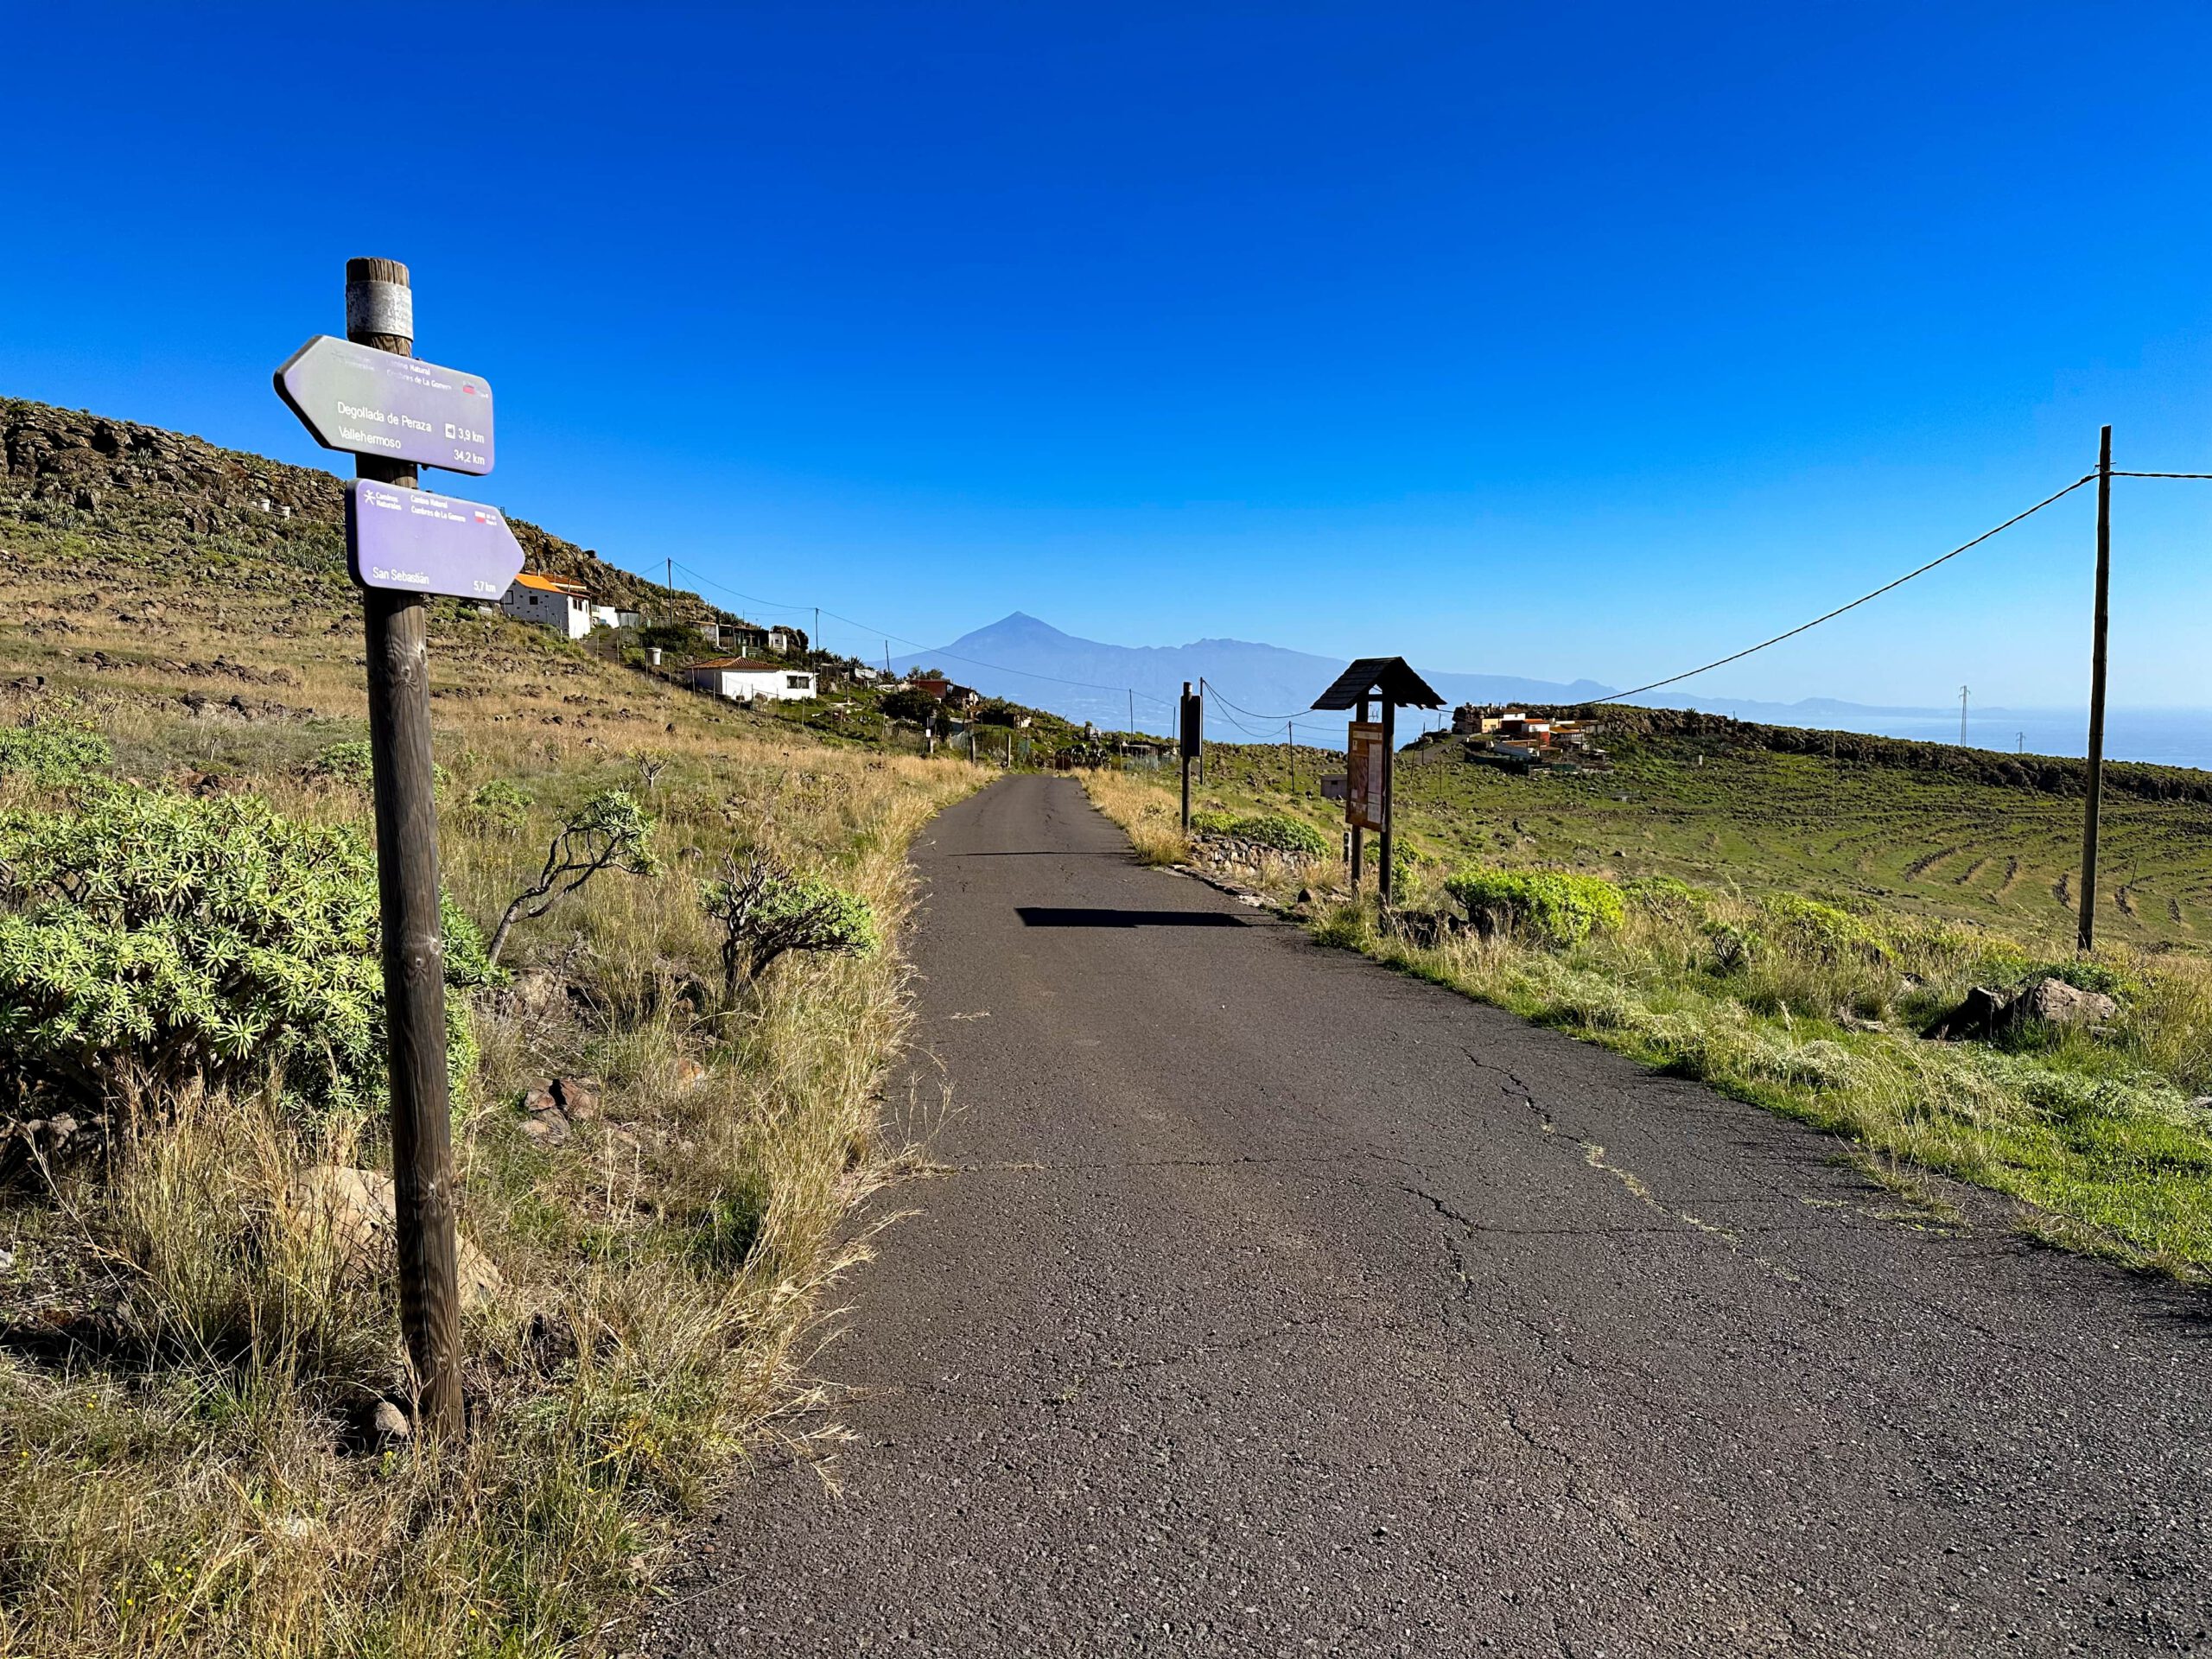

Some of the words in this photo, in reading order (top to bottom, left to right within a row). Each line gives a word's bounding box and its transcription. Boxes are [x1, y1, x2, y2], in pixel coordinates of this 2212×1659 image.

[410, 364, 431, 376] Natural
[337, 401, 385, 420] Degollada
[387, 412, 398, 425] de
[402, 415, 432, 432] Peraza
[339, 425, 401, 448] Vallehermoso
[458, 428, 471, 442] 3,9
[473, 431, 485, 444] km
[454, 449, 471, 463] 34,2
[473, 453, 485, 465] km
[372, 566, 389, 580] San
[391, 569, 429, 584] Sebastián
[474, 580, 484, 593] 5,7
[486, 582, 496, 593] km
